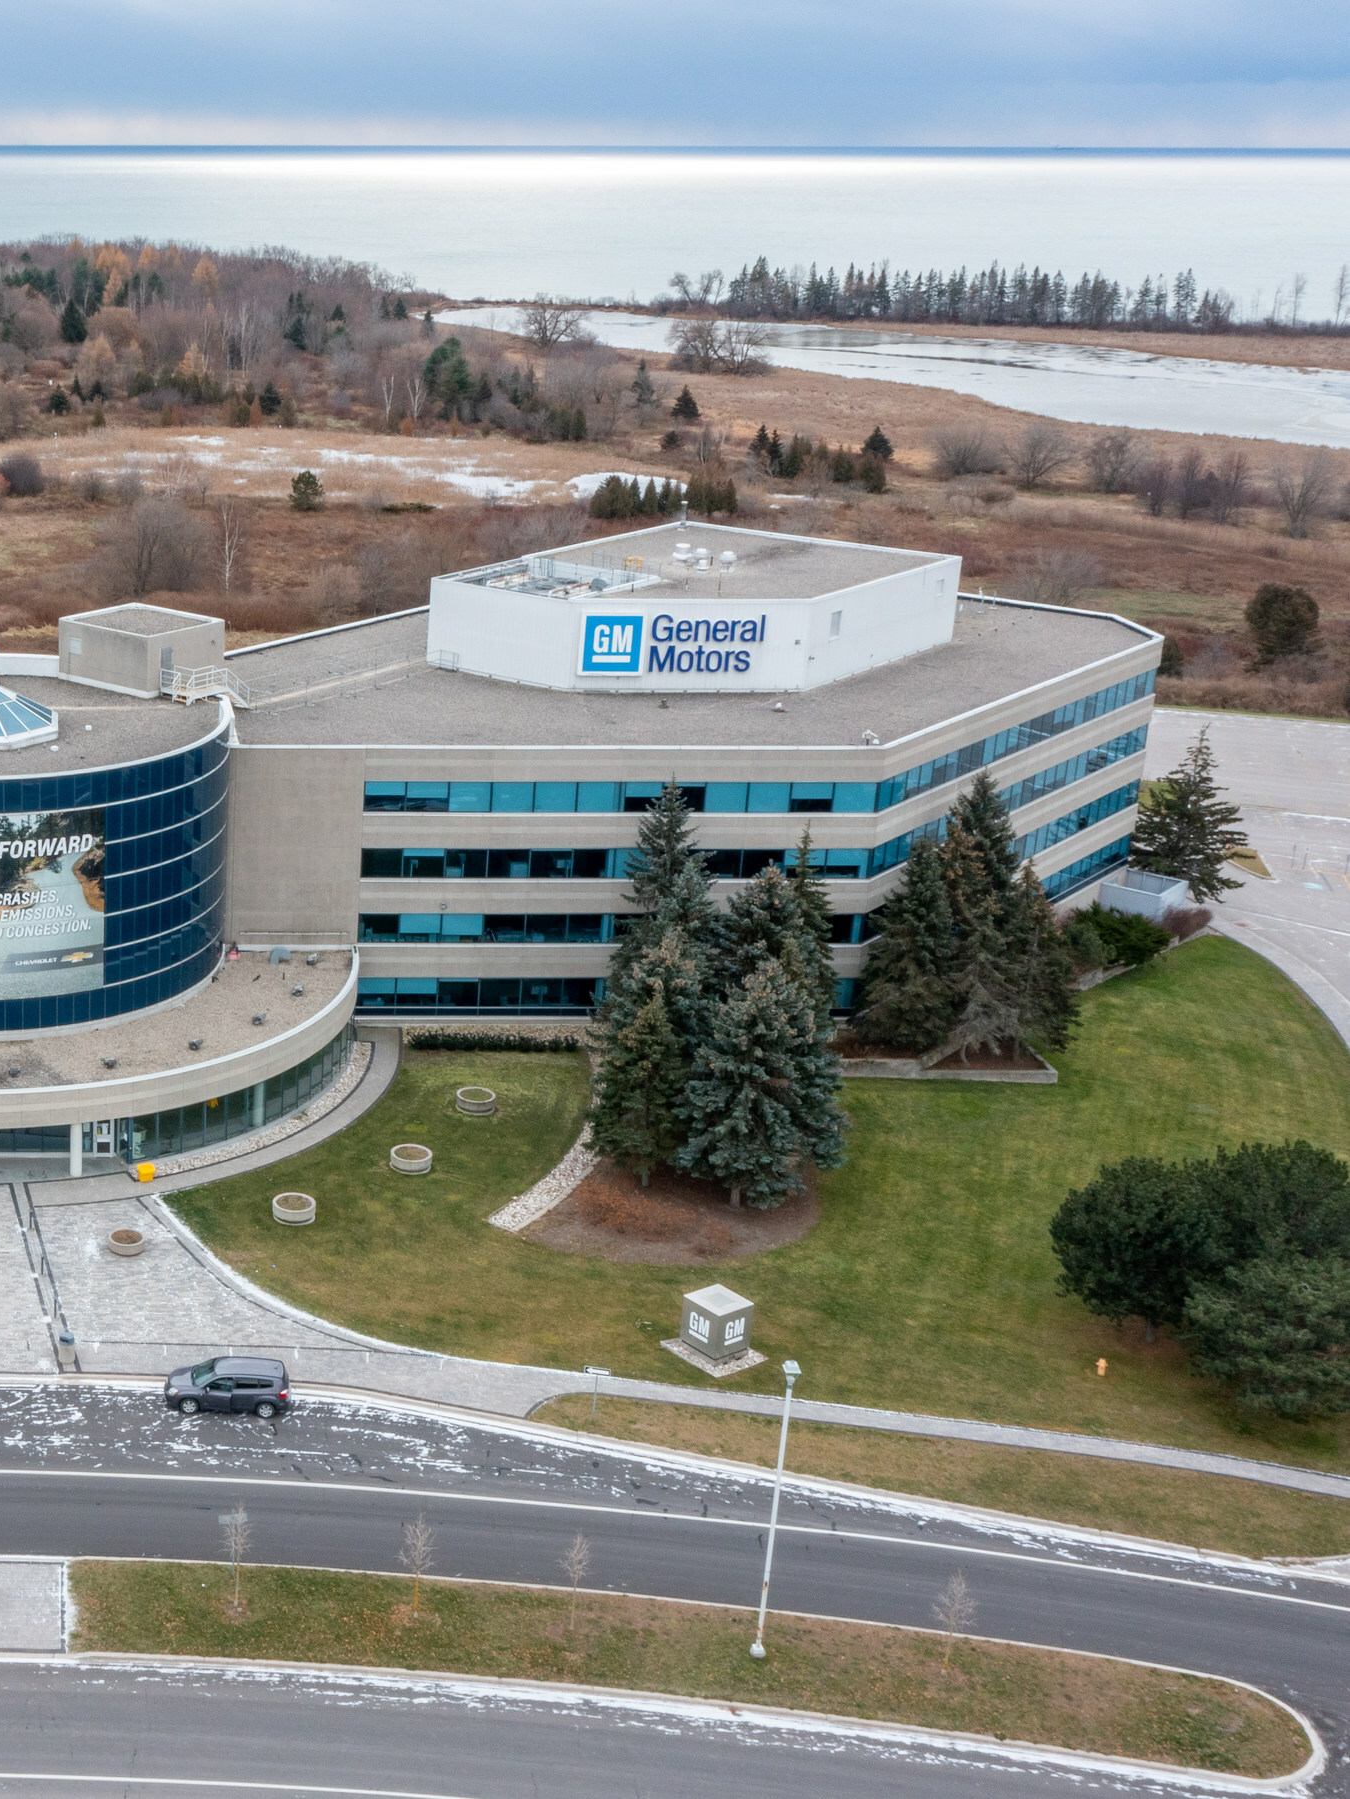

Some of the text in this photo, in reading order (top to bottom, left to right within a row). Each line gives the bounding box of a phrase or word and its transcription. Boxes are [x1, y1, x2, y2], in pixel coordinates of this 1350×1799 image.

[592, 624, 634, 653] GM
[651, 614, 766, 642] General
[648, 645, 750, 673] Motors
[0, 904, 77, 922] EMISSIONS,
[5, 918, 92, 938] CONGESTION.
[15, 957, 58, 966] CHEVROLET
[689, 1311, 710, 1338] GM
[725, 1317, 745, 1340] GM
